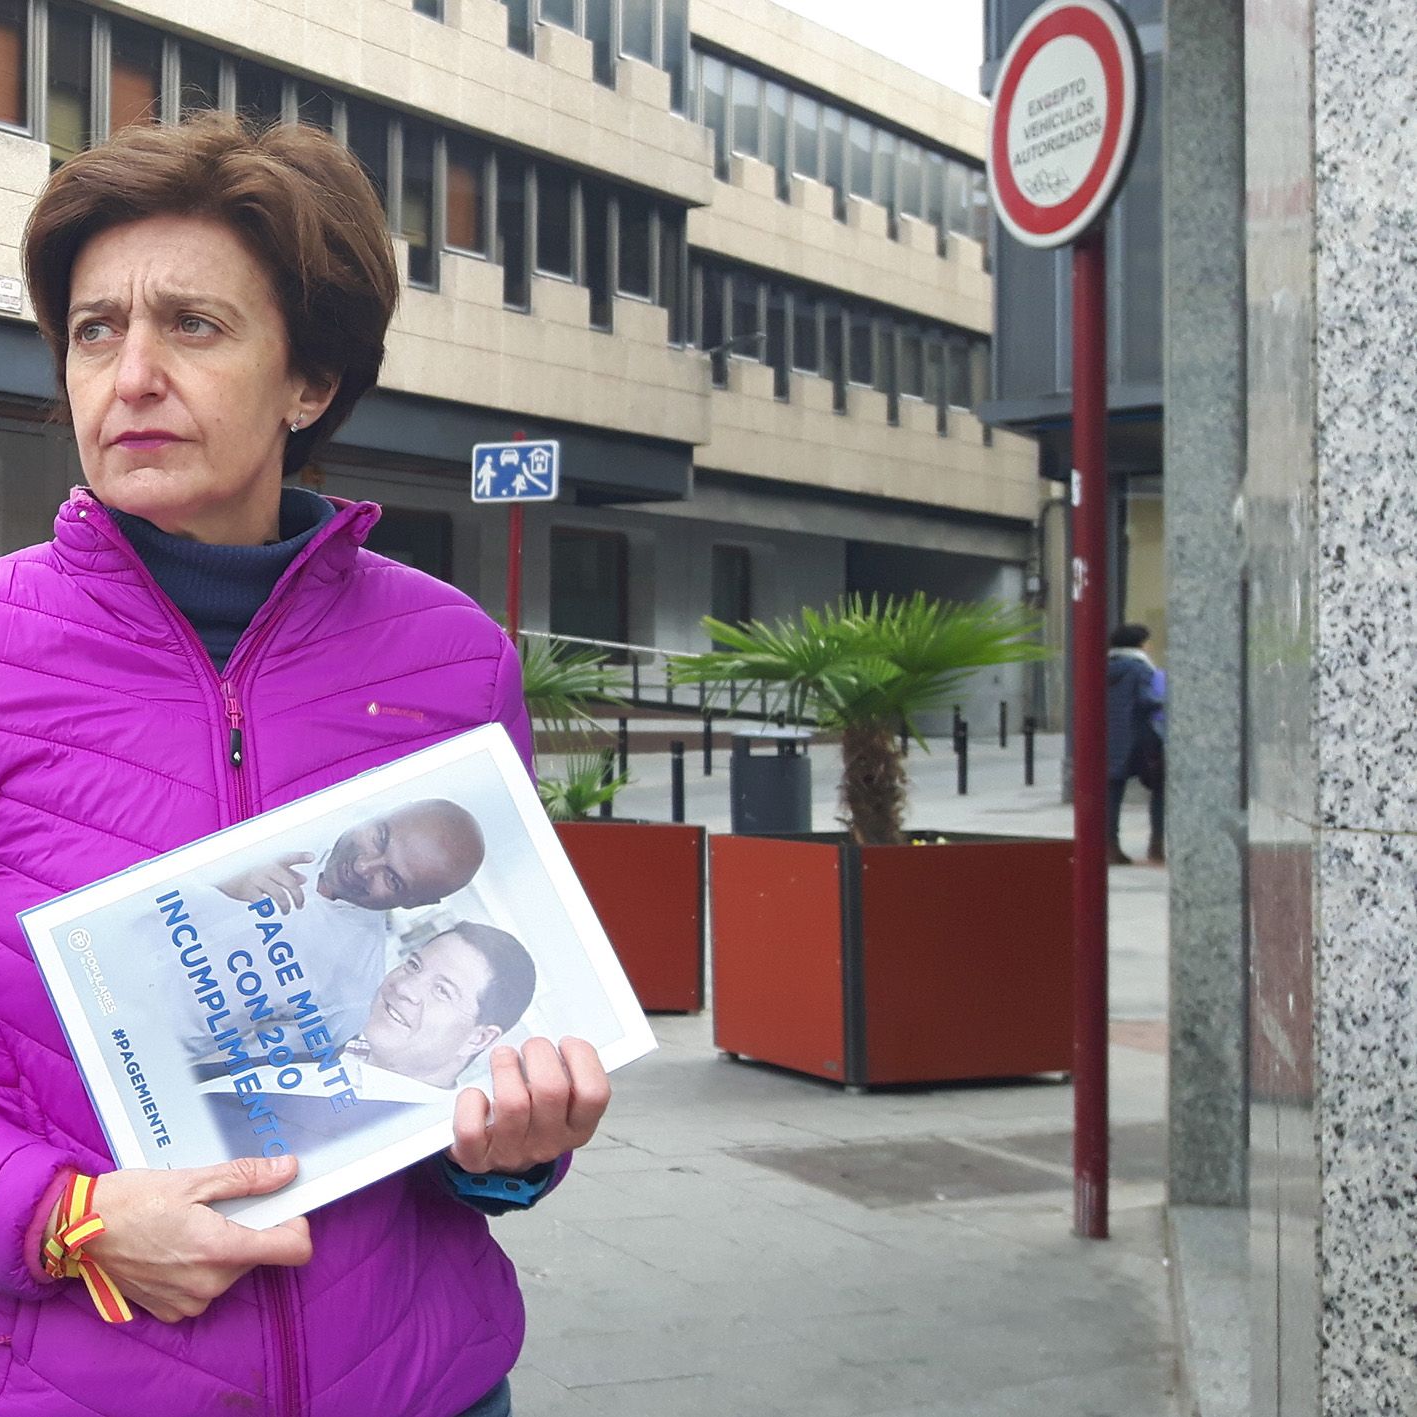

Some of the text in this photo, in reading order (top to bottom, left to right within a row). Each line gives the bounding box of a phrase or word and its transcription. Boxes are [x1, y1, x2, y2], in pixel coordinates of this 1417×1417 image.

[1013, 118, 1102, 166] AUTORIZADOS
[1028, 77, 1086, 117] EXCEPTO
[84, 949, 117, 1014] POPULARES
[155, 889, 291, 1158] INCUMPLIMIENTO
[227, 949, 303, 1090] CON 200
[248, 897, 358, 1113] PAGE MIENTE
[111, 1028, 171, 1149] #PAGEMIENTE
